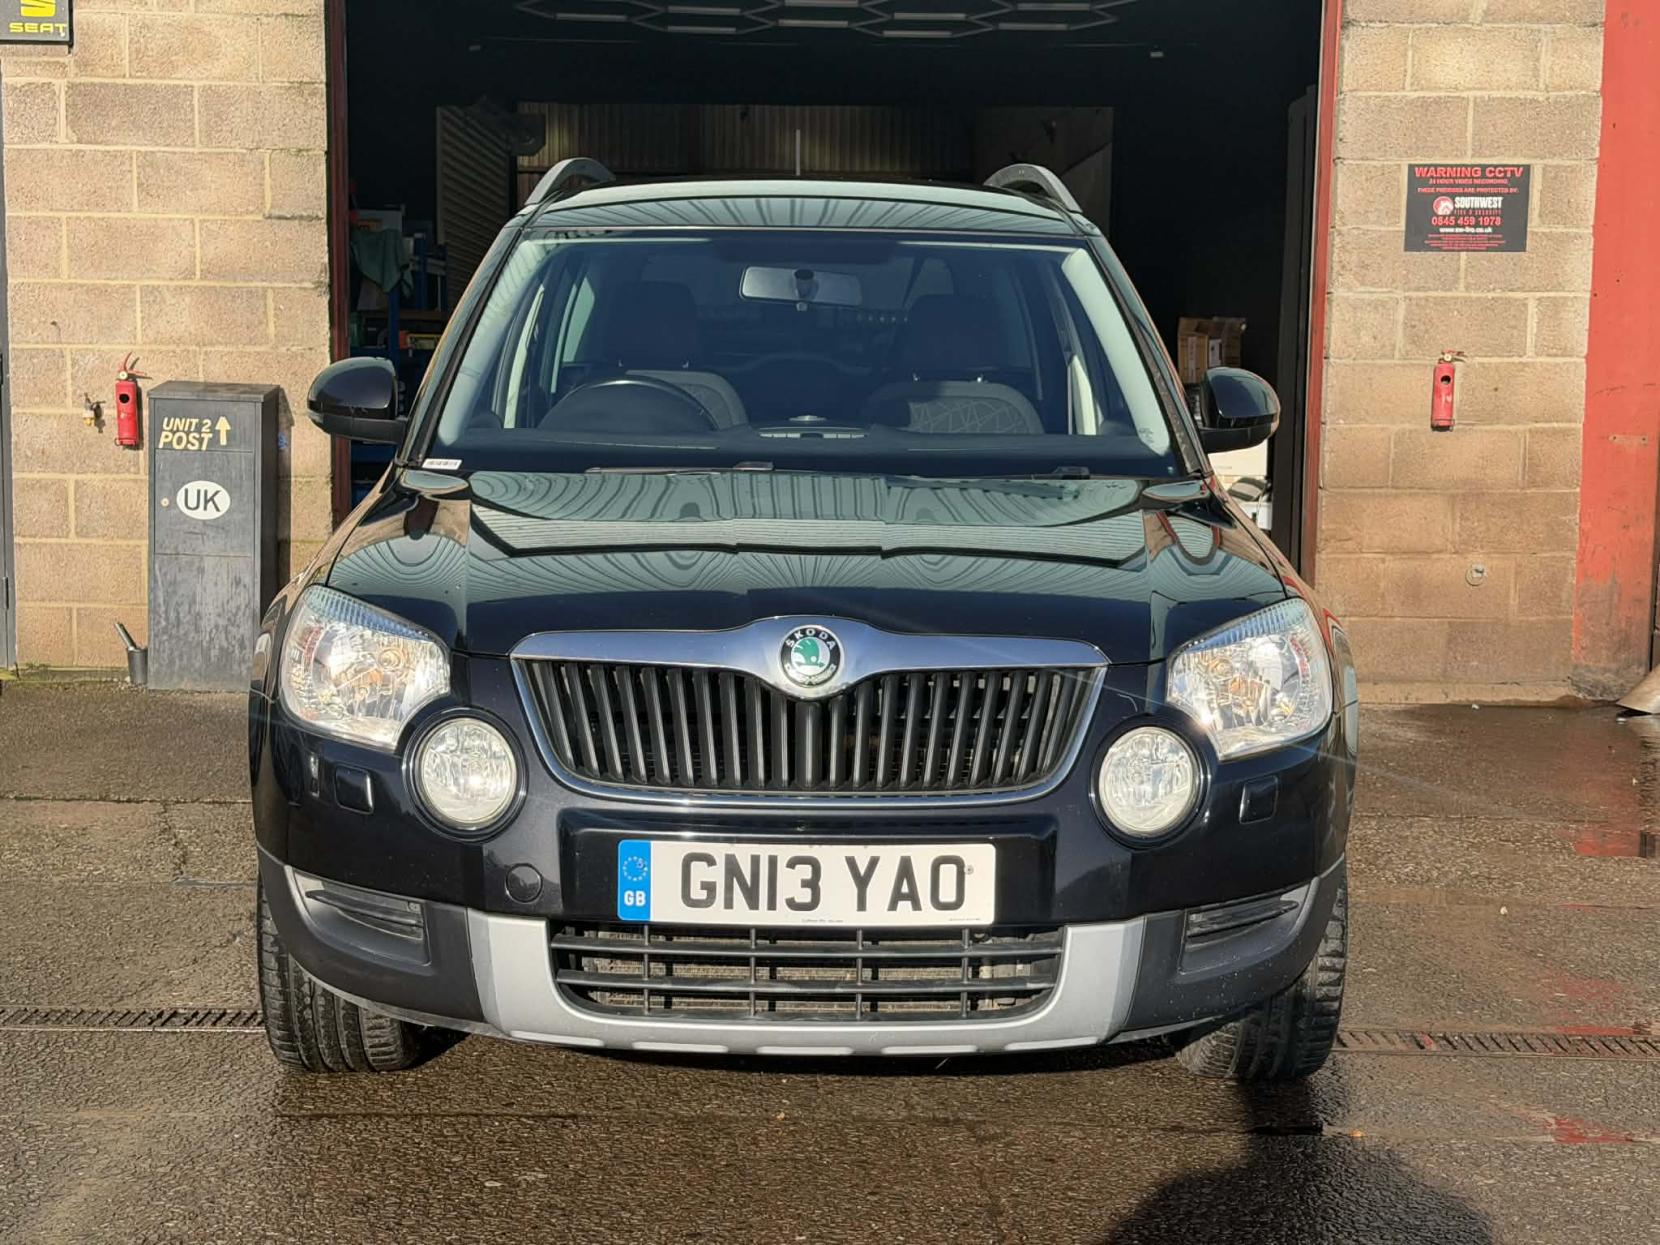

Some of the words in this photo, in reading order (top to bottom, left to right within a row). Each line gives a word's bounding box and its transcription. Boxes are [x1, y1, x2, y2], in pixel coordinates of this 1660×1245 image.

[9, 22, 67, 33] SEAT
[1414, 167, 1482, 177] WARNING
[1485, 167, 1524, 177] CCTV
[1454, 197, 1504, 209] SOUTHWEST
[1431, 216, 1455, 226] 0845
[1457, 217, 1475, 226] 459
[1478, 217, 1502, 226] 1978
[162, 417, 199, 431] UNIT
[201, 419, 212, 432] 2
[158, 431, 213, 451] POST
[183, 488, 222, 512] UK
[681, 852, 821, 912] GN13
[845, 855, 966, 912] YAO
[624, 890, 646, 907] GB
